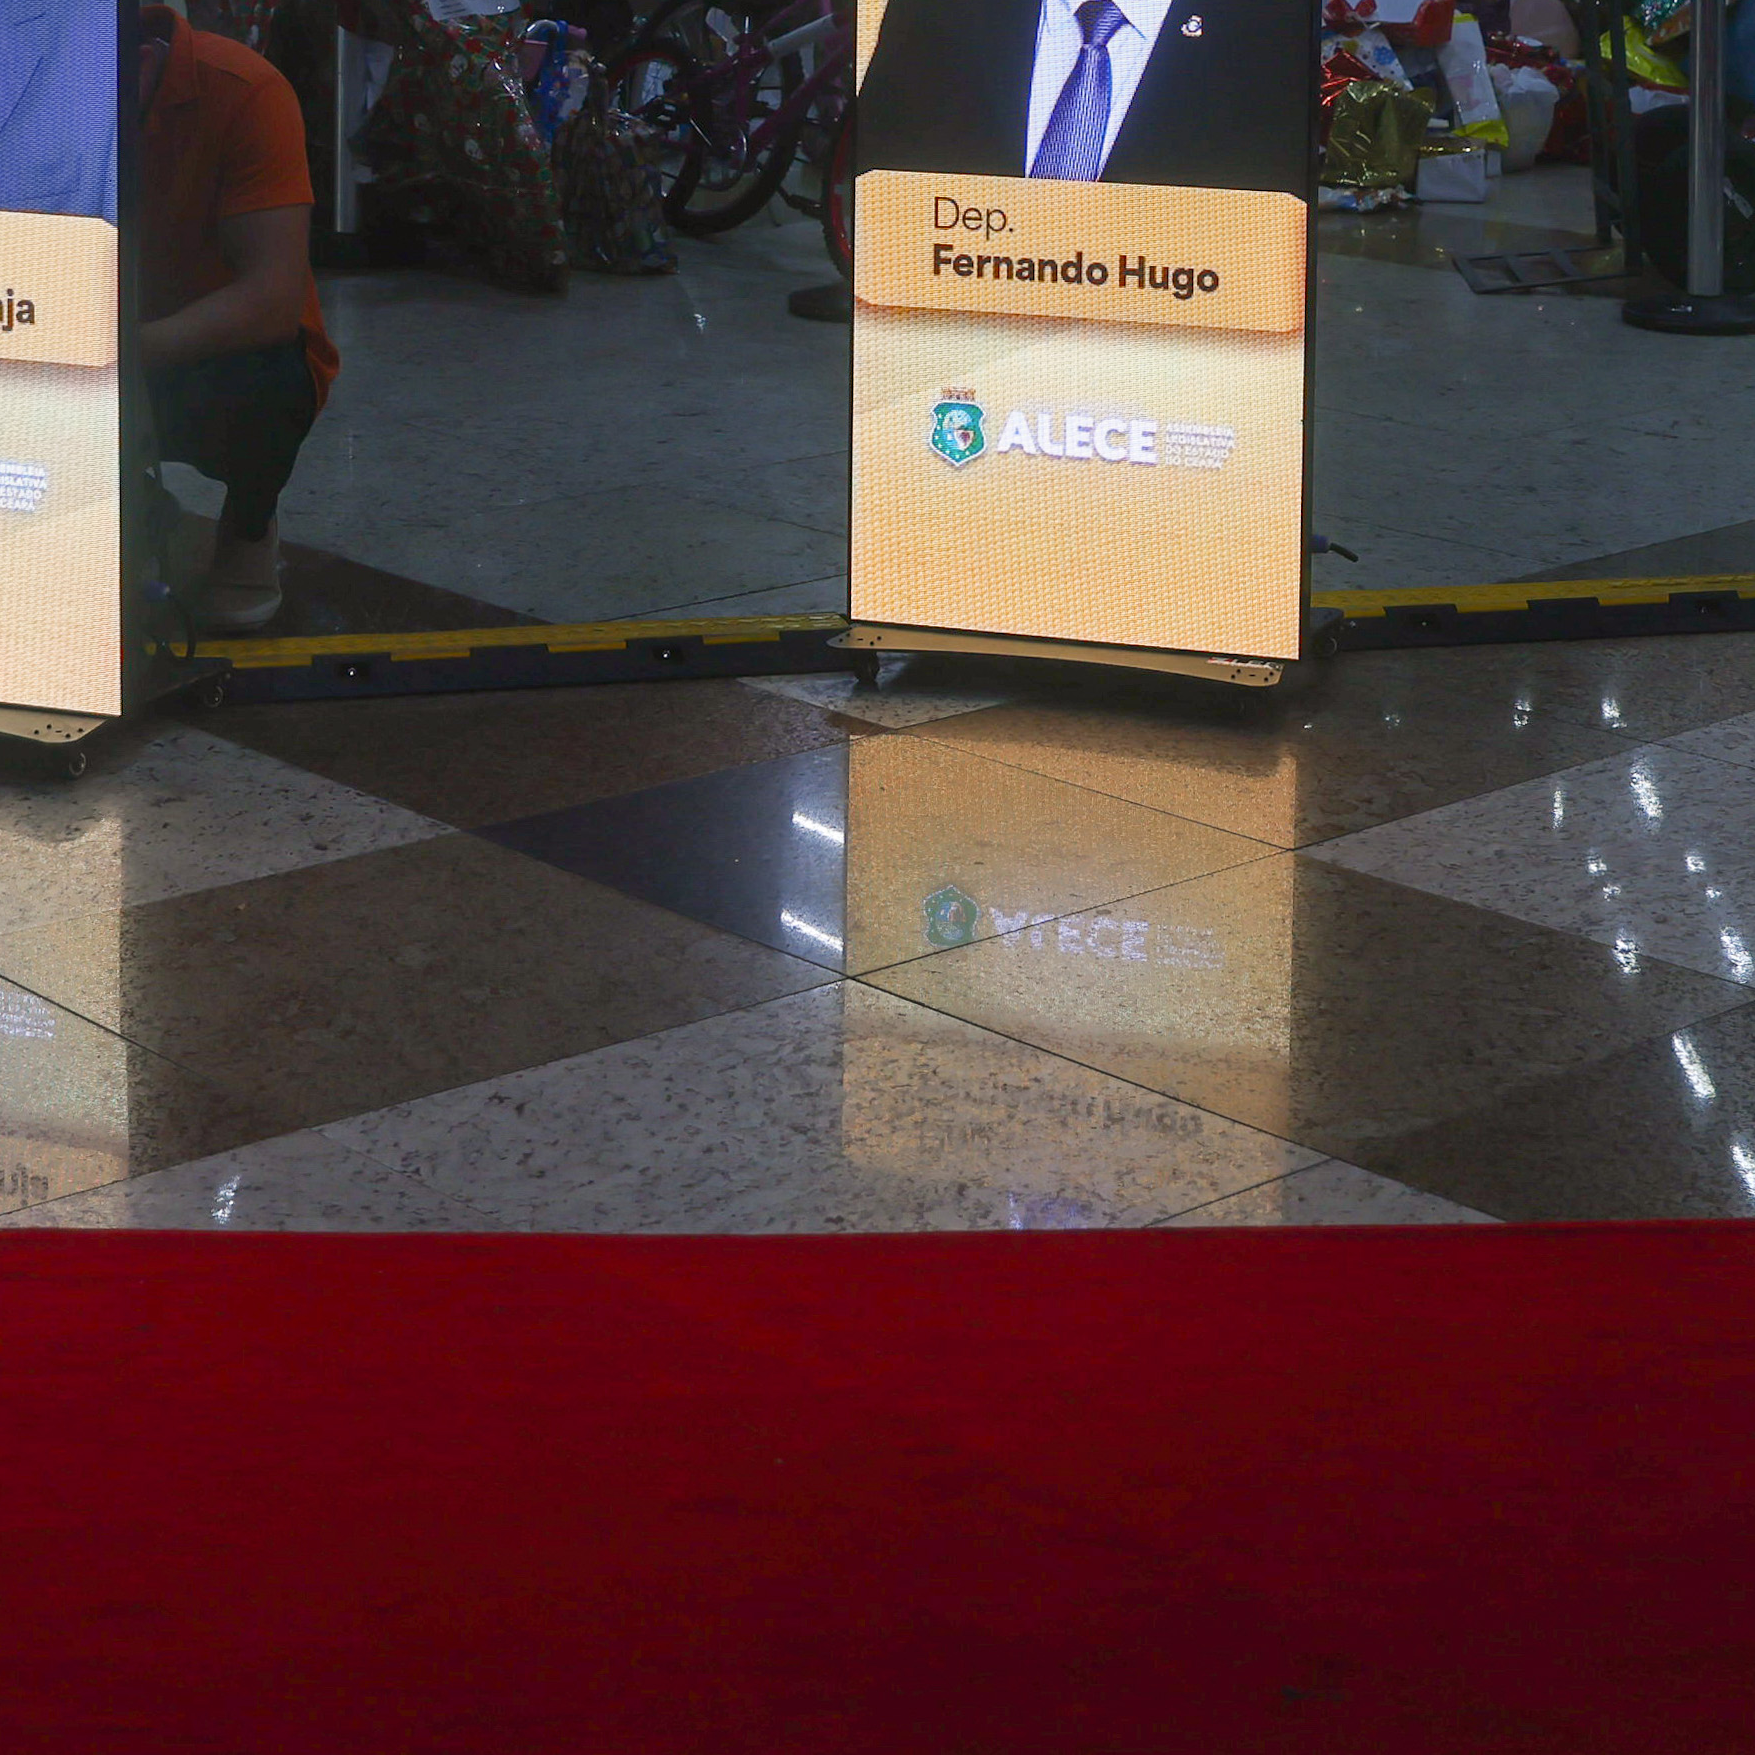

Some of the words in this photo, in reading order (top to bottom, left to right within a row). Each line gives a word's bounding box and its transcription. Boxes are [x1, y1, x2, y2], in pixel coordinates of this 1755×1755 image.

[933, 196, 1015, 241] Dep.
[932, 243, 1109, 286] Fernando
[1118, 254, 1220, 301] Hugo
[997, 409, 1158, 465] ALECE
